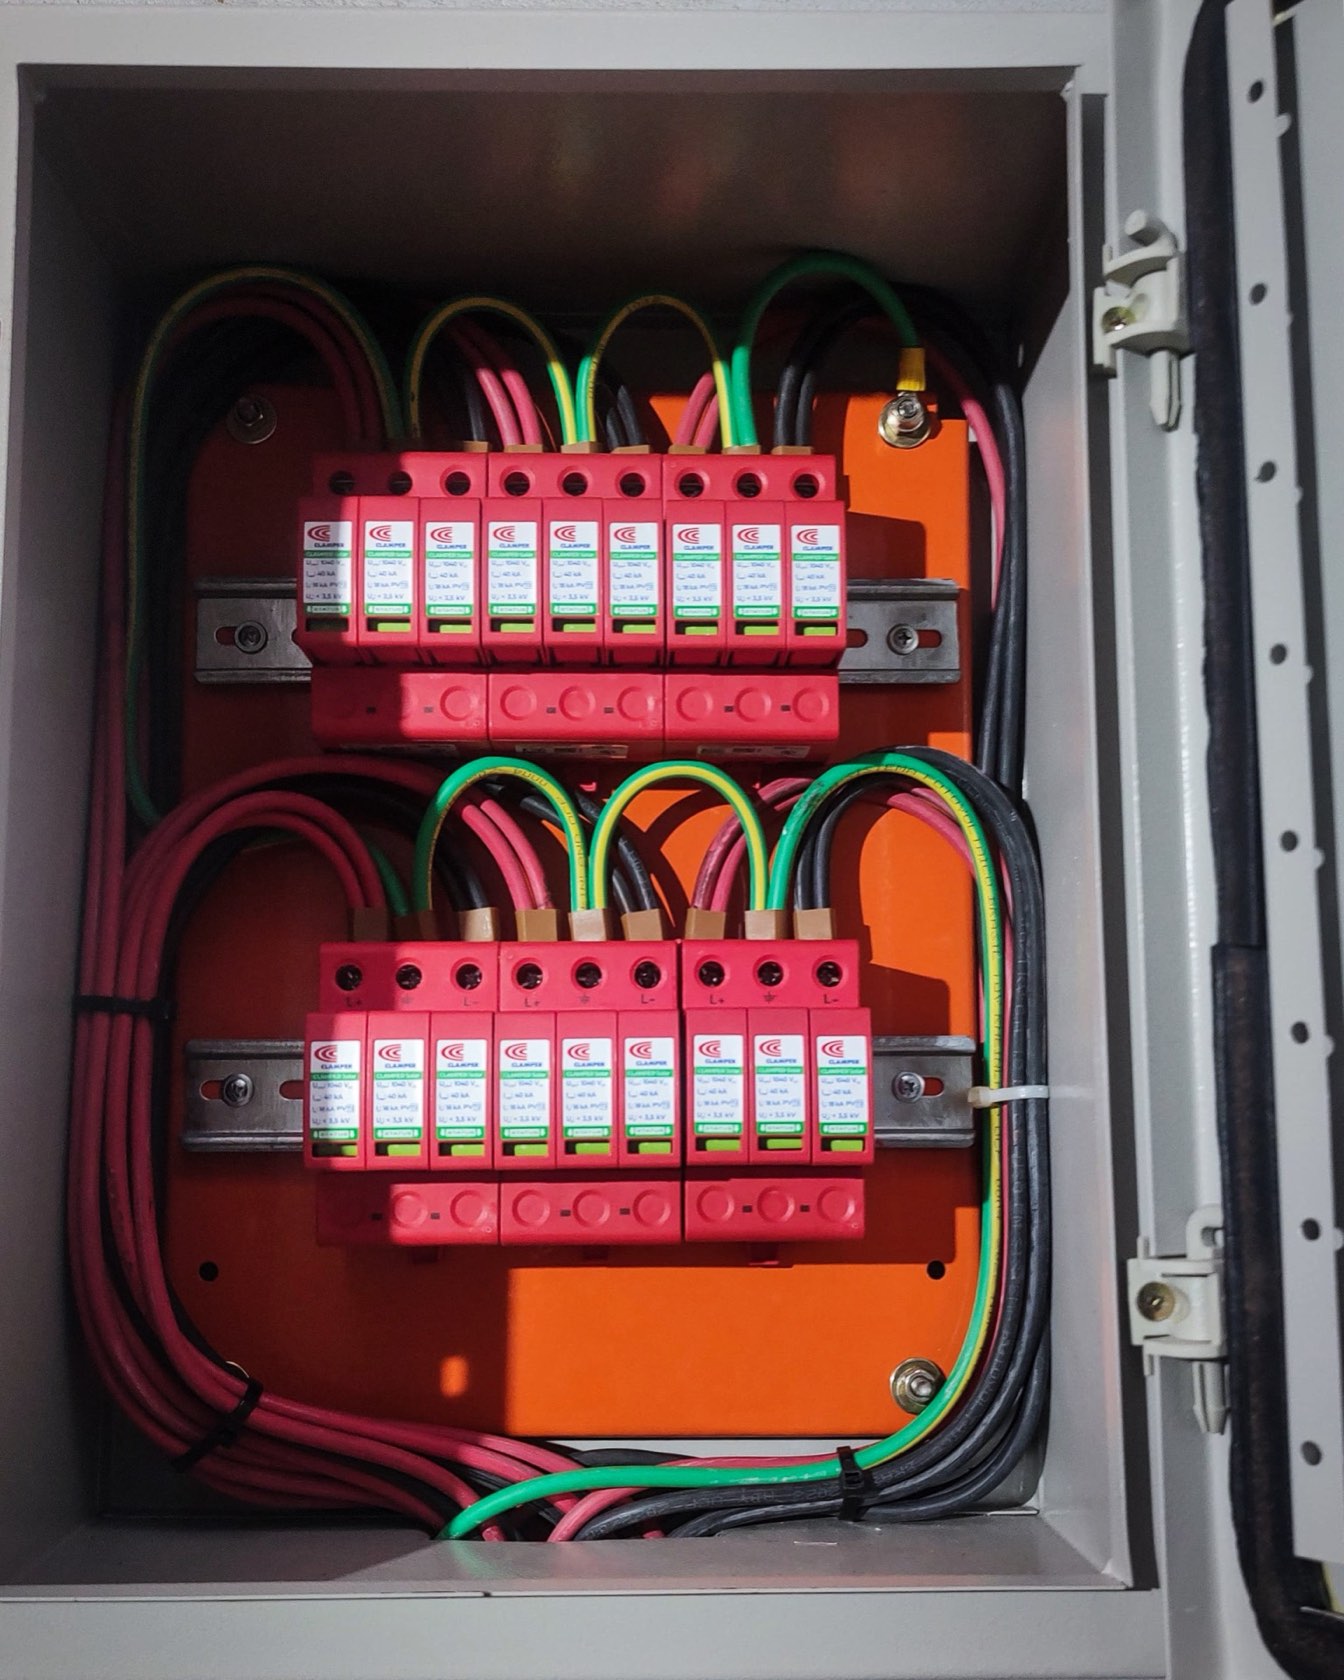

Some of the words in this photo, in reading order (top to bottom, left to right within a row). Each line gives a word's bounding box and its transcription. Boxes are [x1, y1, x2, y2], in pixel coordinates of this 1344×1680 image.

[640, 994, 656, 1004] L-
[710, 994, 724, 1004] L+
[824, 994, 839, 1004] L-
